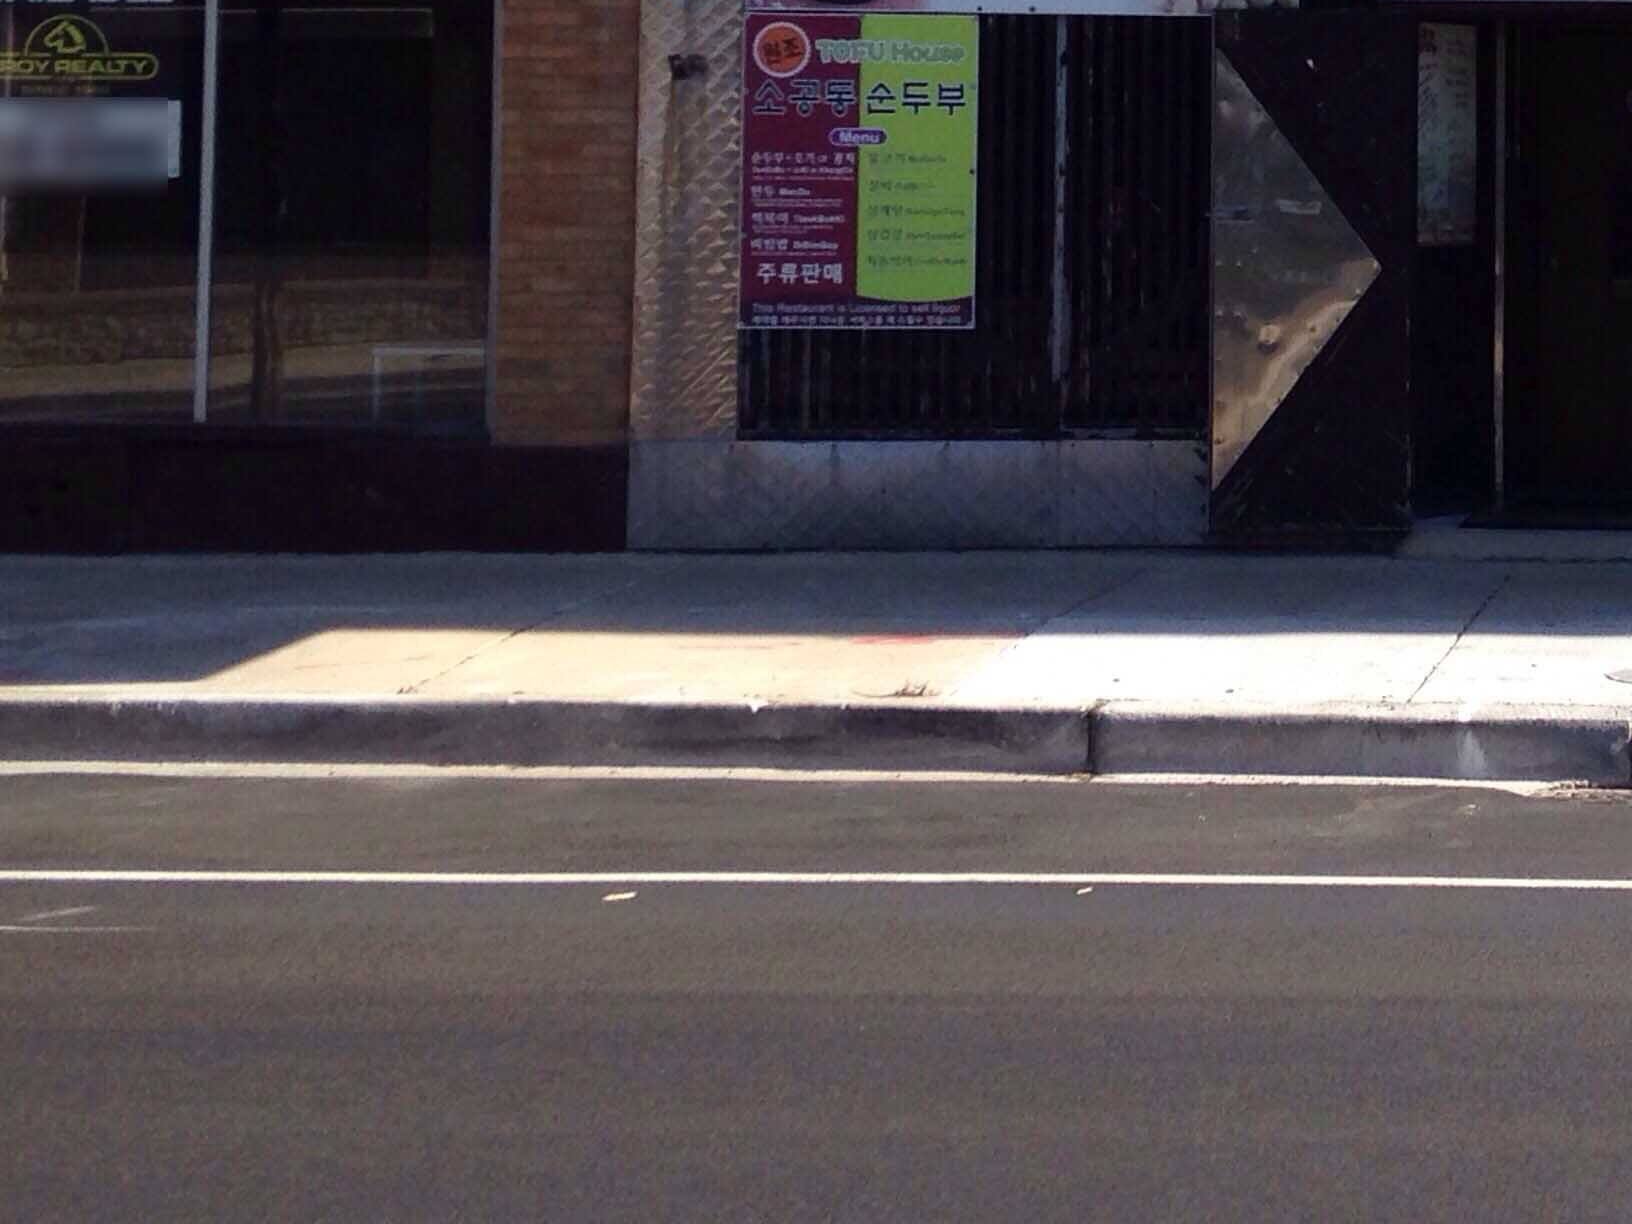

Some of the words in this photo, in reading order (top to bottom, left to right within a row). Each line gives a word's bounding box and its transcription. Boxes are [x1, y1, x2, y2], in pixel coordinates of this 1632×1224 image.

[815, 39, 885, 64] TOFU
[55, 59, 148, 73] REALTY
[752, 79, 857, 116] 소공동
[866, 82, 966, 116] 순두부
[838, 131, 880, 144] Menu
[756, 262, 843, 284] 주류판매
